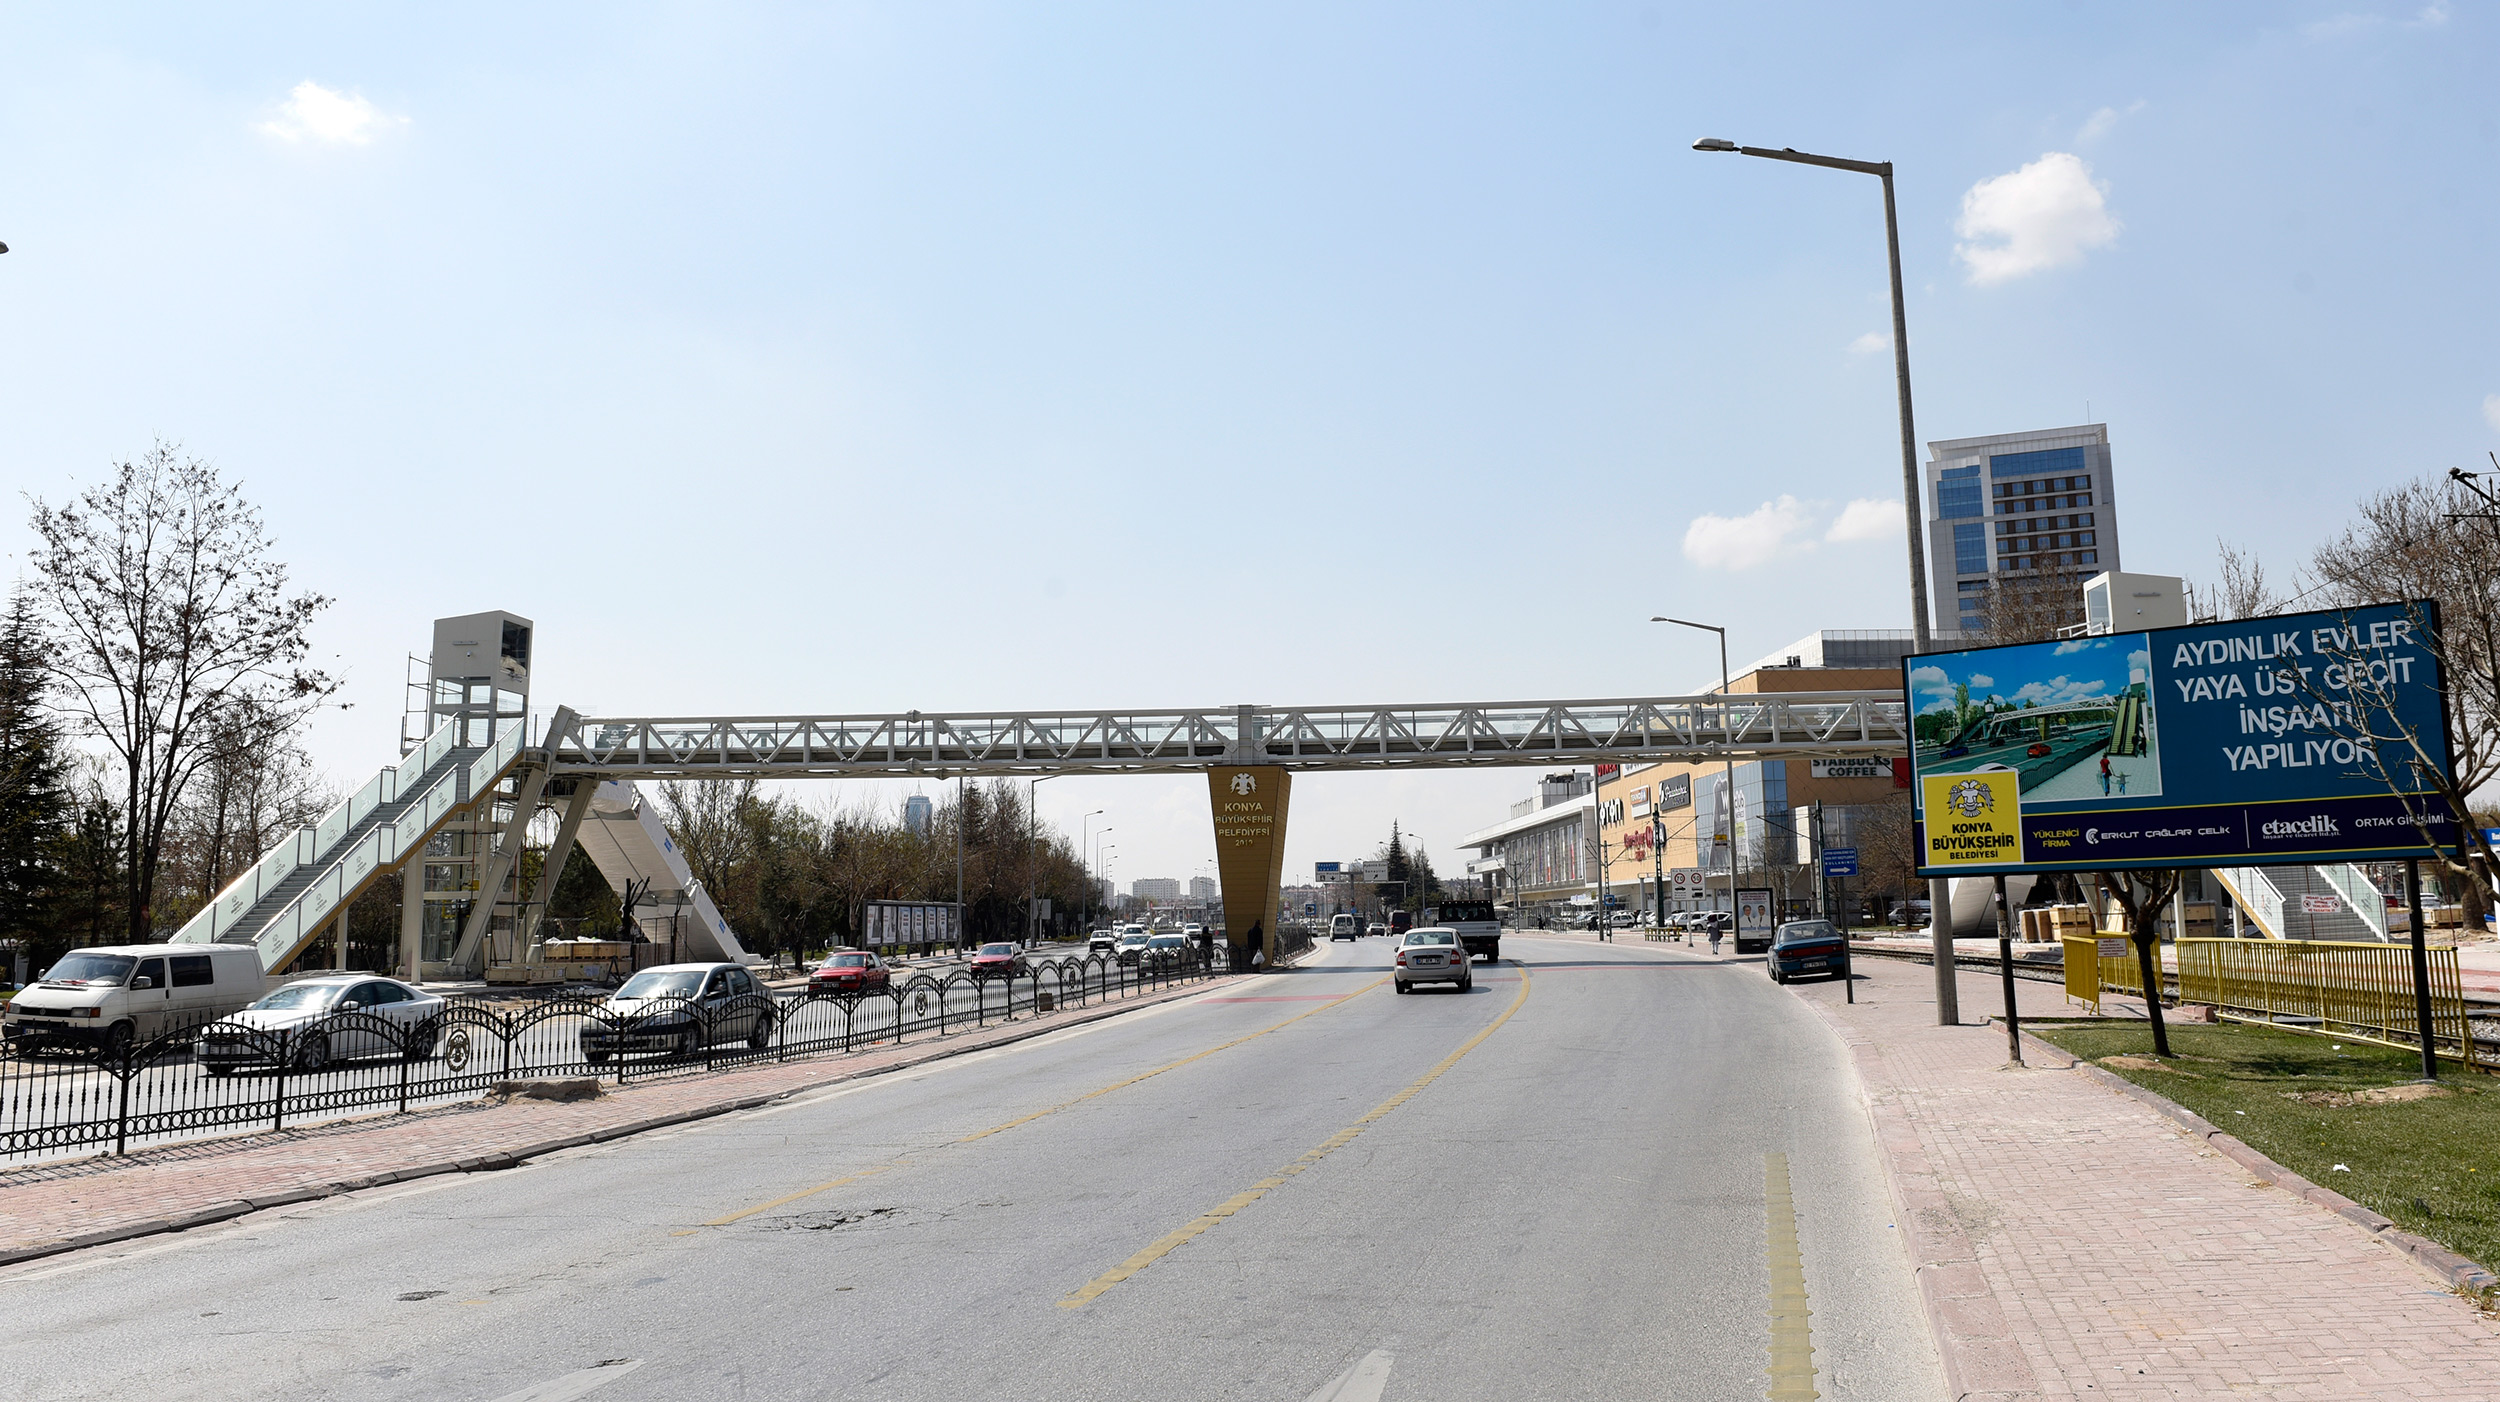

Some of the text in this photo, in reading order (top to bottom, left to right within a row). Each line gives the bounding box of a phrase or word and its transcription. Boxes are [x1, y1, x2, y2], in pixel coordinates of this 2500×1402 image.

[2172, 620, 2415, 668] AYDINLIK EVLER
[2174, 653, 2415, 703] YAYA ÜST GEÇİT
[2239, 700, 2353, 738] İNŞAATI
[2222, 737, 2377, 772] YAPILIYOR
[1828, 767, 1878, 776] COFFEE
[1224, 802, 1263, 812] KONYA
[1952, 822, 1993, 834] KONYA
[2355, 816, 2394, 828] ORTAK
[1218, 827, 1270, 837] BELEDİYESİ
[2032, 828, 2080, 839] YÜKLENİCİ
[2101, 825, 2231, 840] ERKUT ÇAĞLAR ÇELİK
[1932, 832, 2015, 851] BÜYÜKŞEHİR
[2042, 839, 2071, 848] FİRMA
[1949, 849, 1999, 860] BELEDİYESİ
